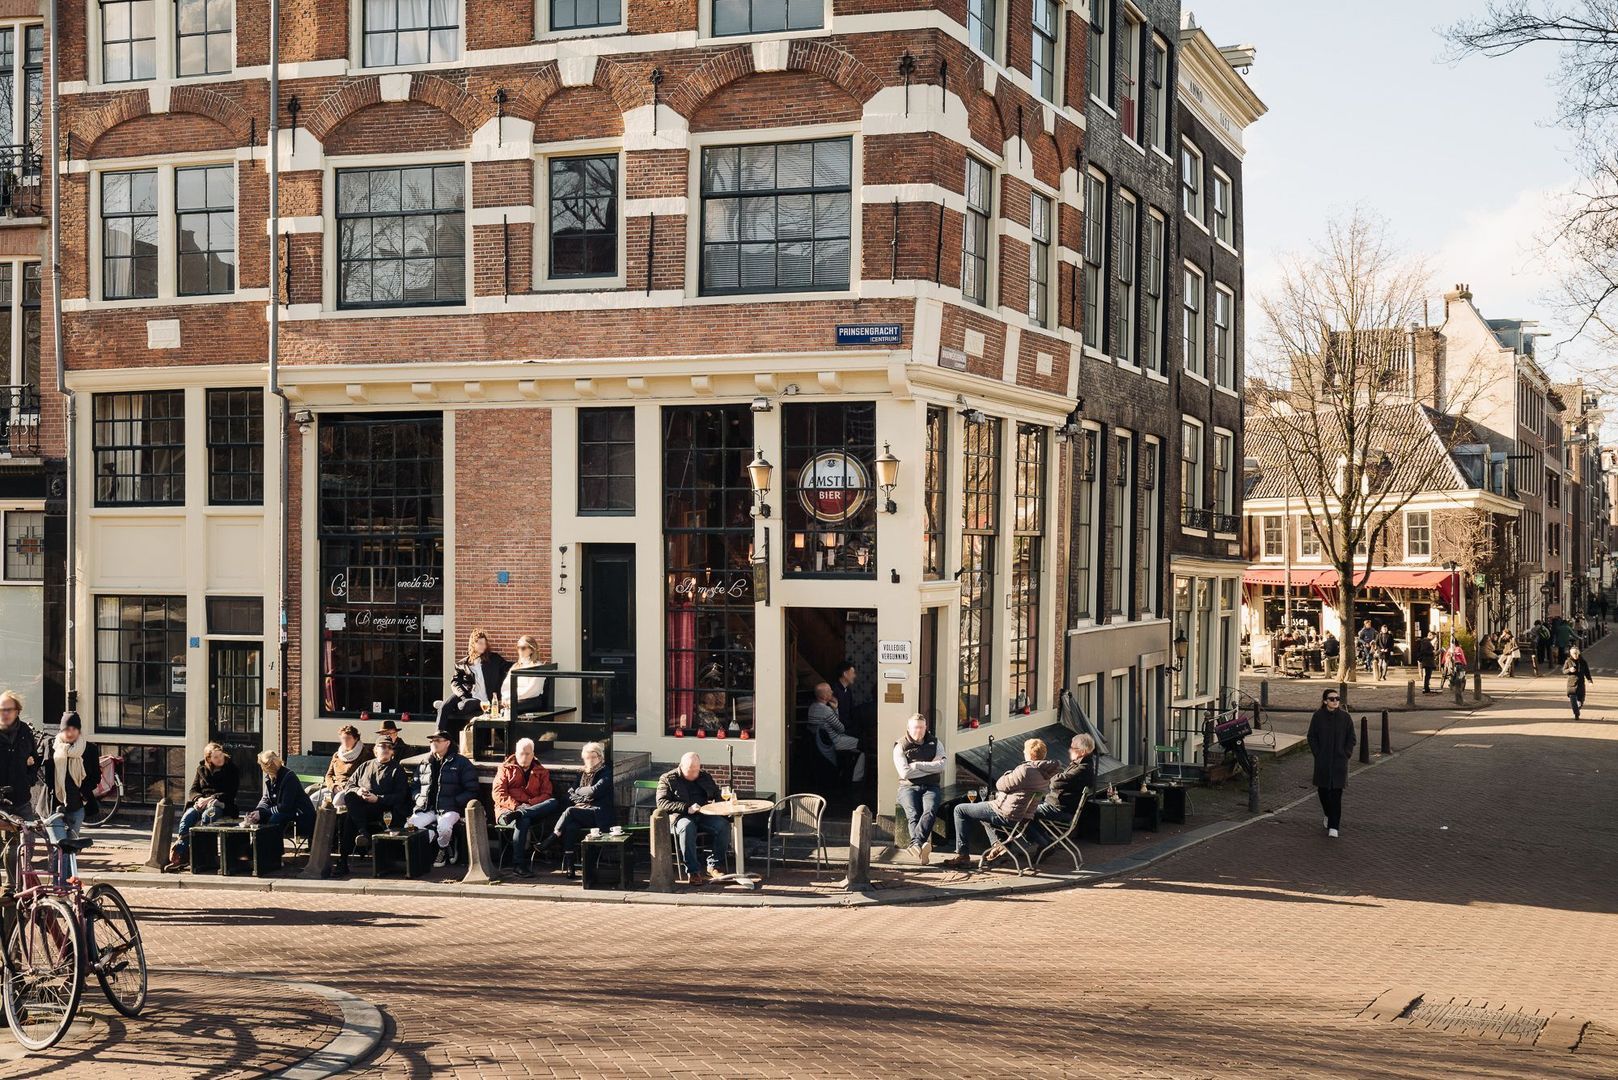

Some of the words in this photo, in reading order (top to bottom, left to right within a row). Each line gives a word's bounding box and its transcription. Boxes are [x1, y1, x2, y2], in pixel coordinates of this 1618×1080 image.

[839, 326, 899, 336] PRINSENGRACHT
[819, 491, 841, 500] BIER
[881, 653, 908, 661] VERGUNNING
